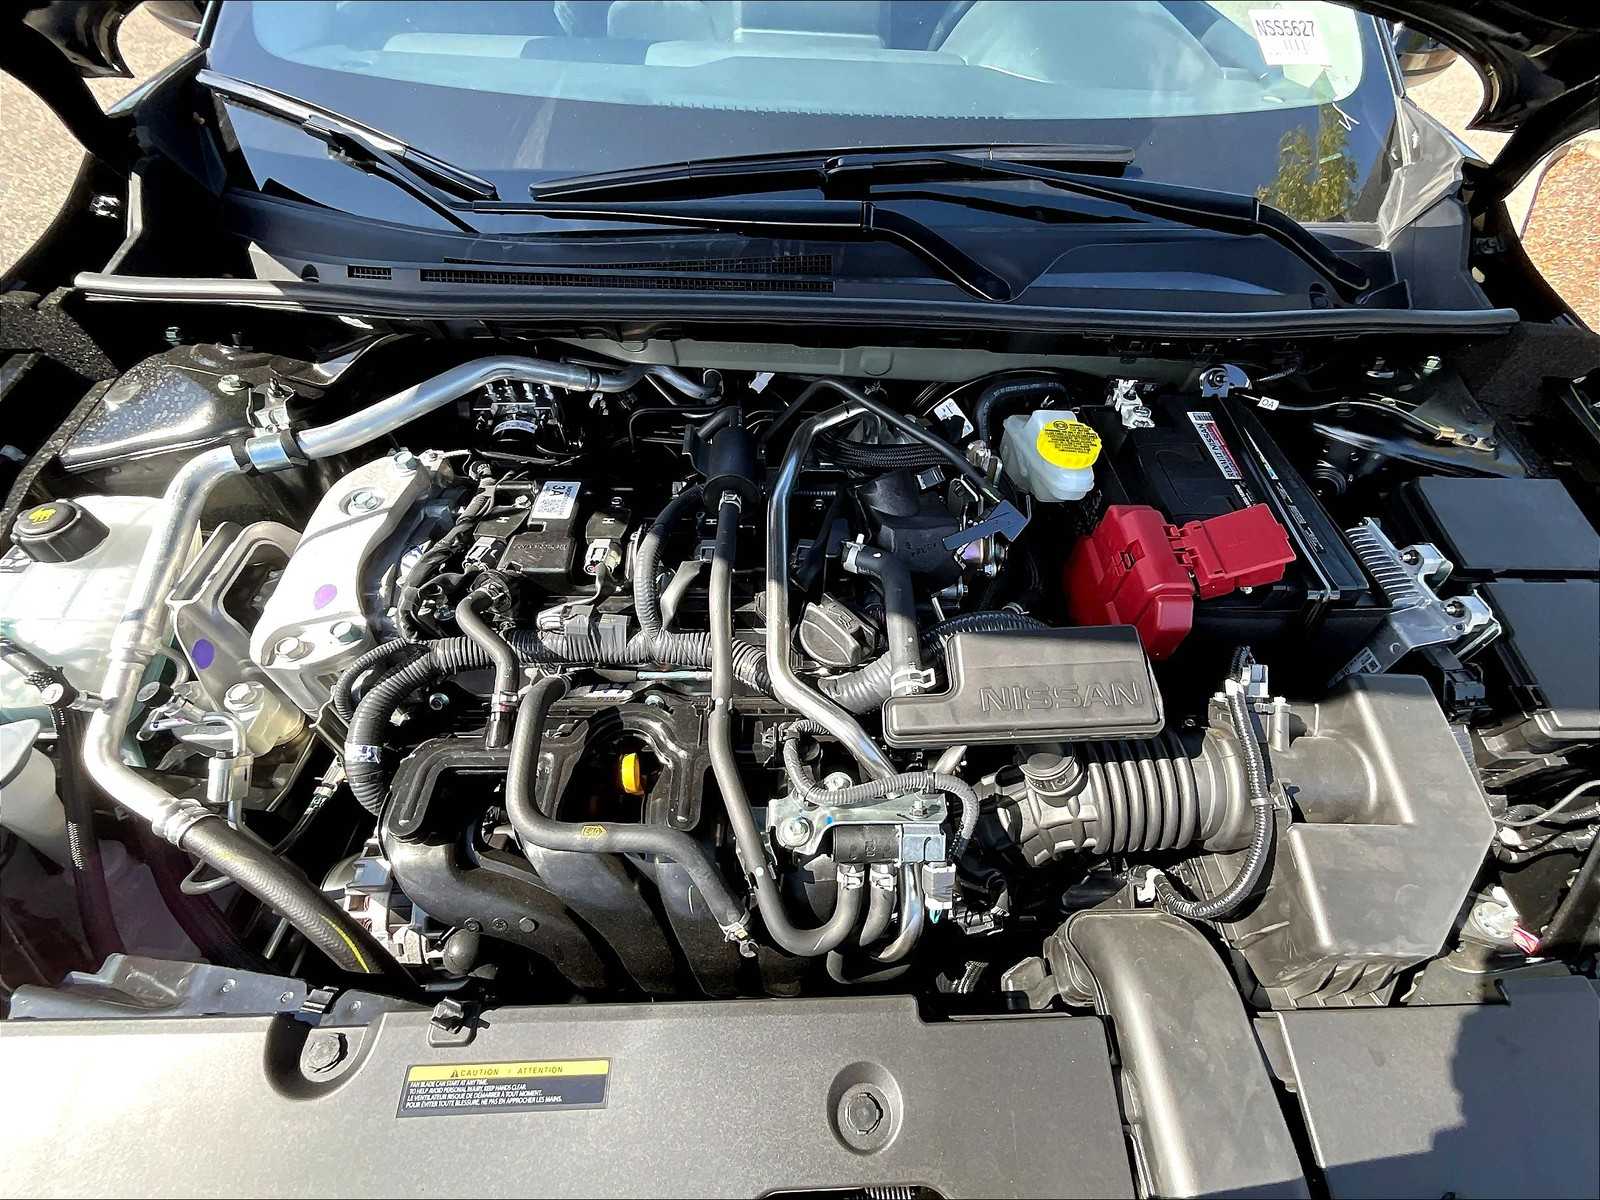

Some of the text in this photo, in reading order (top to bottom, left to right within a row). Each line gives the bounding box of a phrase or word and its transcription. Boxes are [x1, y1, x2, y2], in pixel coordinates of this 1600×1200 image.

[1255, 19, 1315, 37] NSS5627
[979, 681, 1144, 712] NISSAN
[460, 1066, 563, 1077] CAUTION ATTENTION
[506, 1096, 536, 1104] APPROCHER
